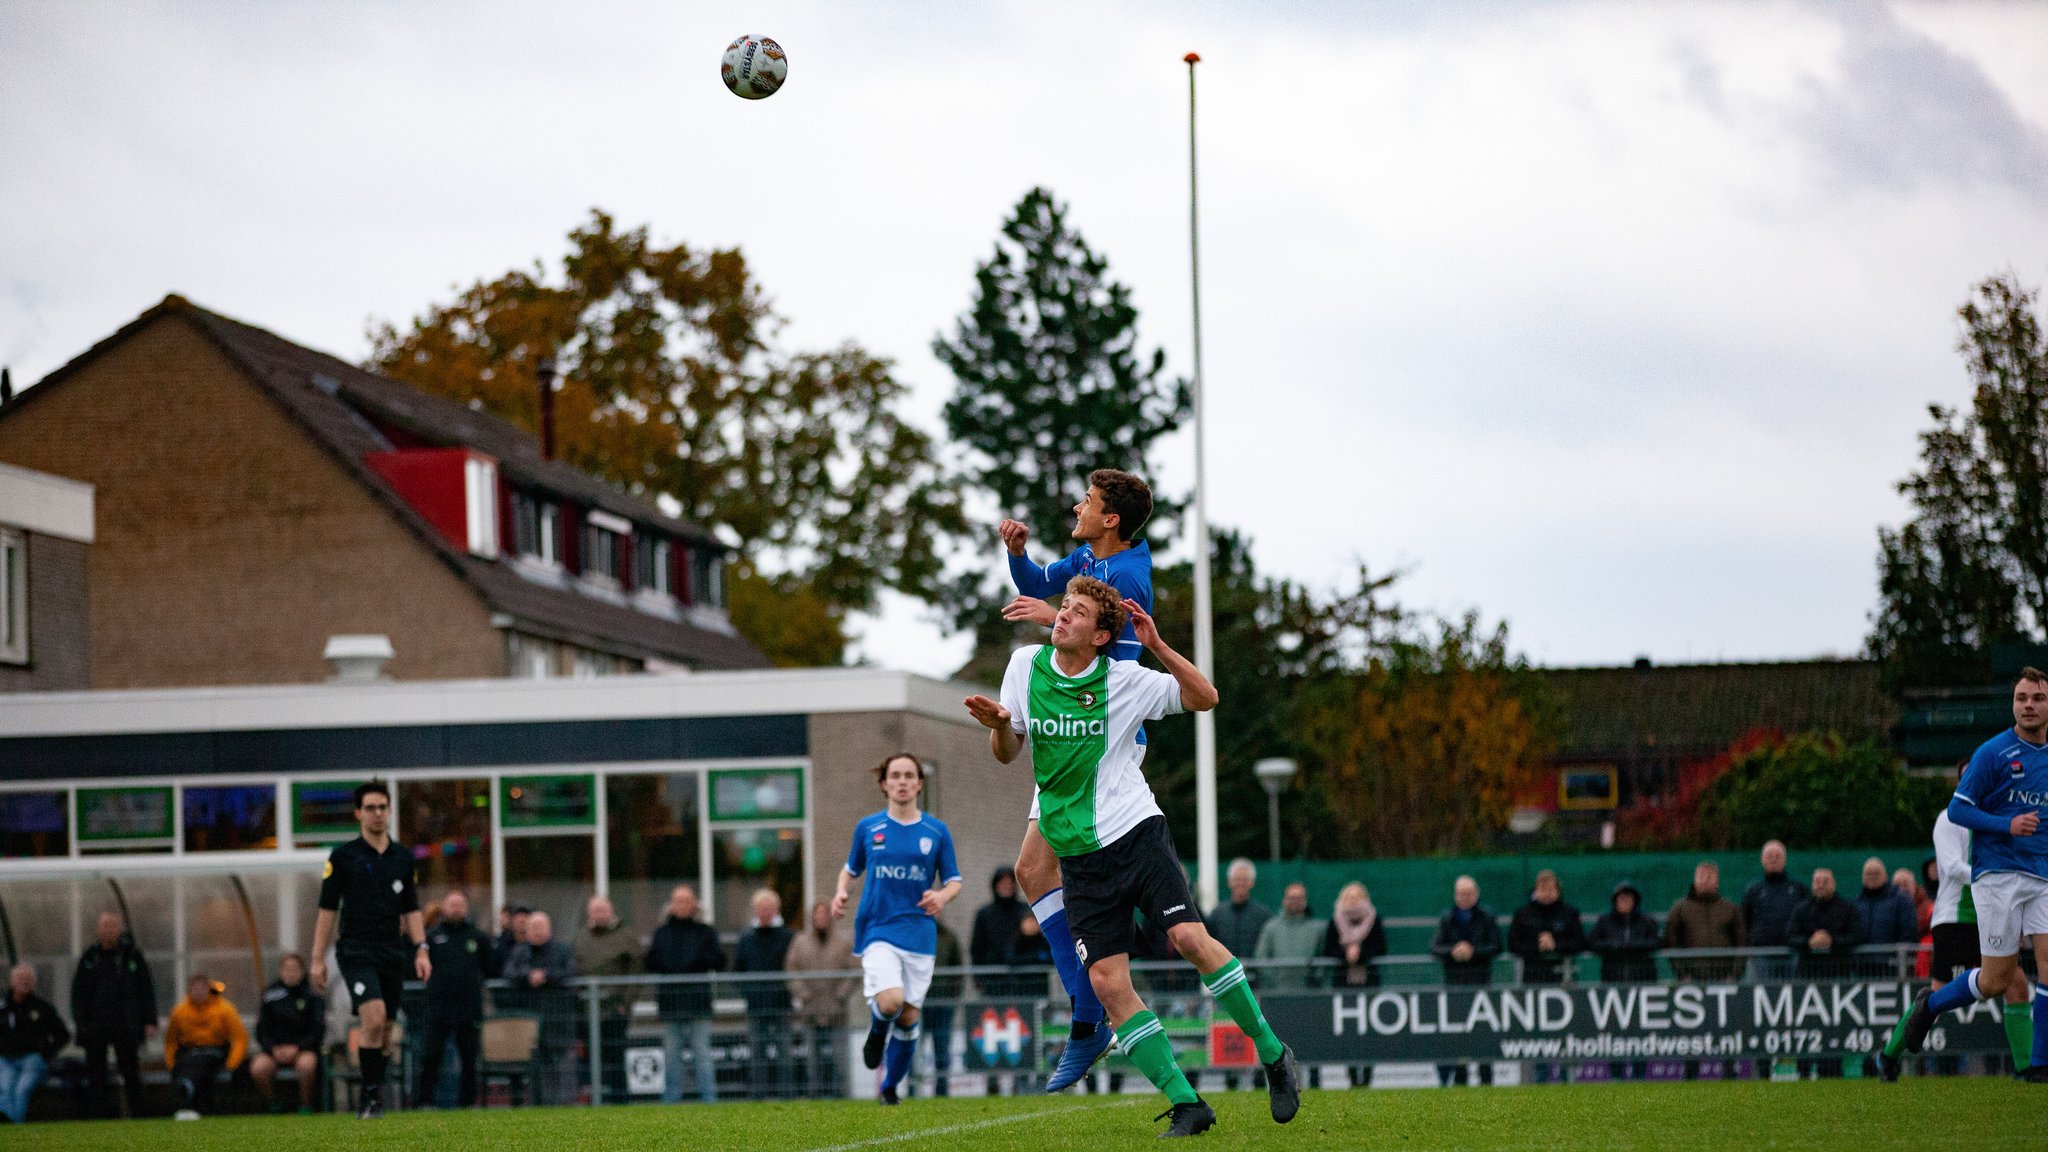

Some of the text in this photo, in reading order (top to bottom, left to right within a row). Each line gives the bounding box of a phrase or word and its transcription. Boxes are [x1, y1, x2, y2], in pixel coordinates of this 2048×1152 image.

[2008, 790, 2040, 805] ING
[875, 865, 906, 880] ING
[1163, 903, 1186, 917] hummel
[1332, 987, 1574, 1036] HOLLAND
[1587, 984, 1738, 1030] WEST
[1500, 1030, 1742, 1058] www.hollandwest.nl
[1765, 1028, 1823, 1053] 0172
[1844, 1028, 1874, 1053] 49
